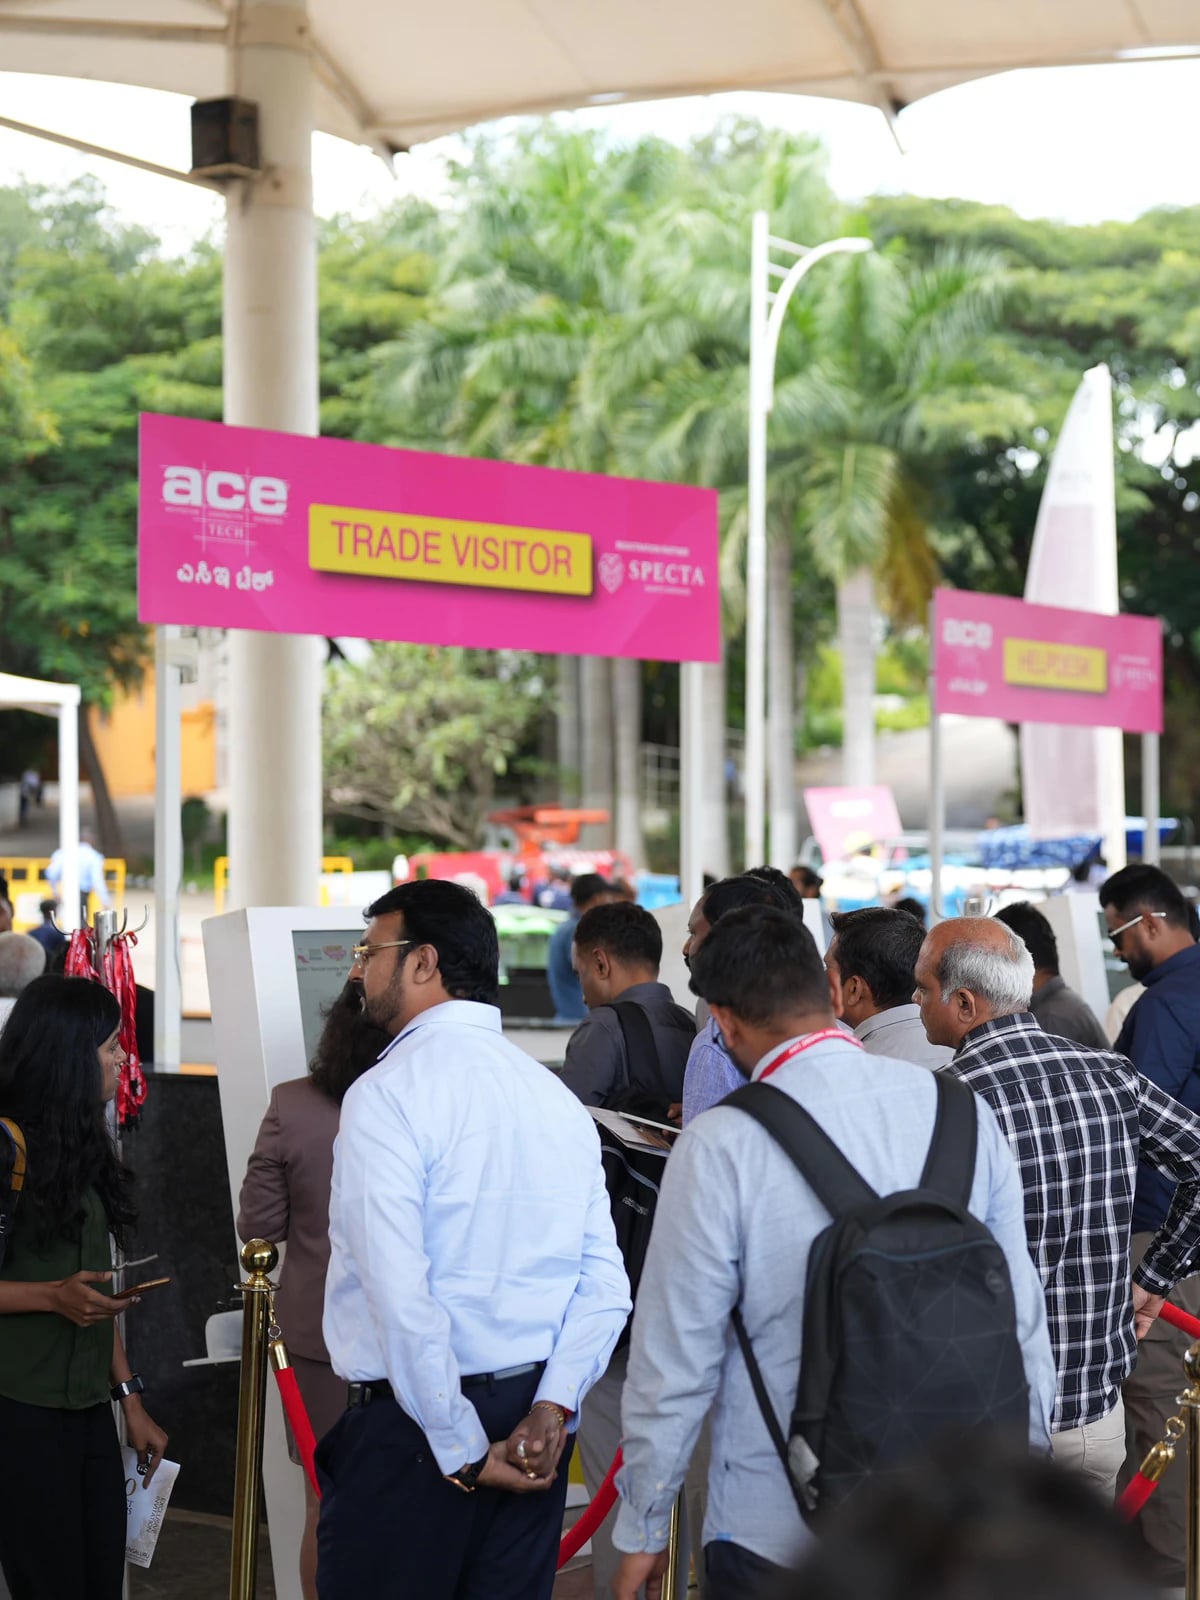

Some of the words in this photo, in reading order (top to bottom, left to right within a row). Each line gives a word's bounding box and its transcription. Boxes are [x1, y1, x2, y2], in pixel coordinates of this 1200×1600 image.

[162, 465, 288, 516] ace
[208, 523, 245, 539] TECH
[330, 520, 442, 565] TRADE
[451, 532, 573, 578] VISITOR
[628, 559, 705, 588] SPECTA
